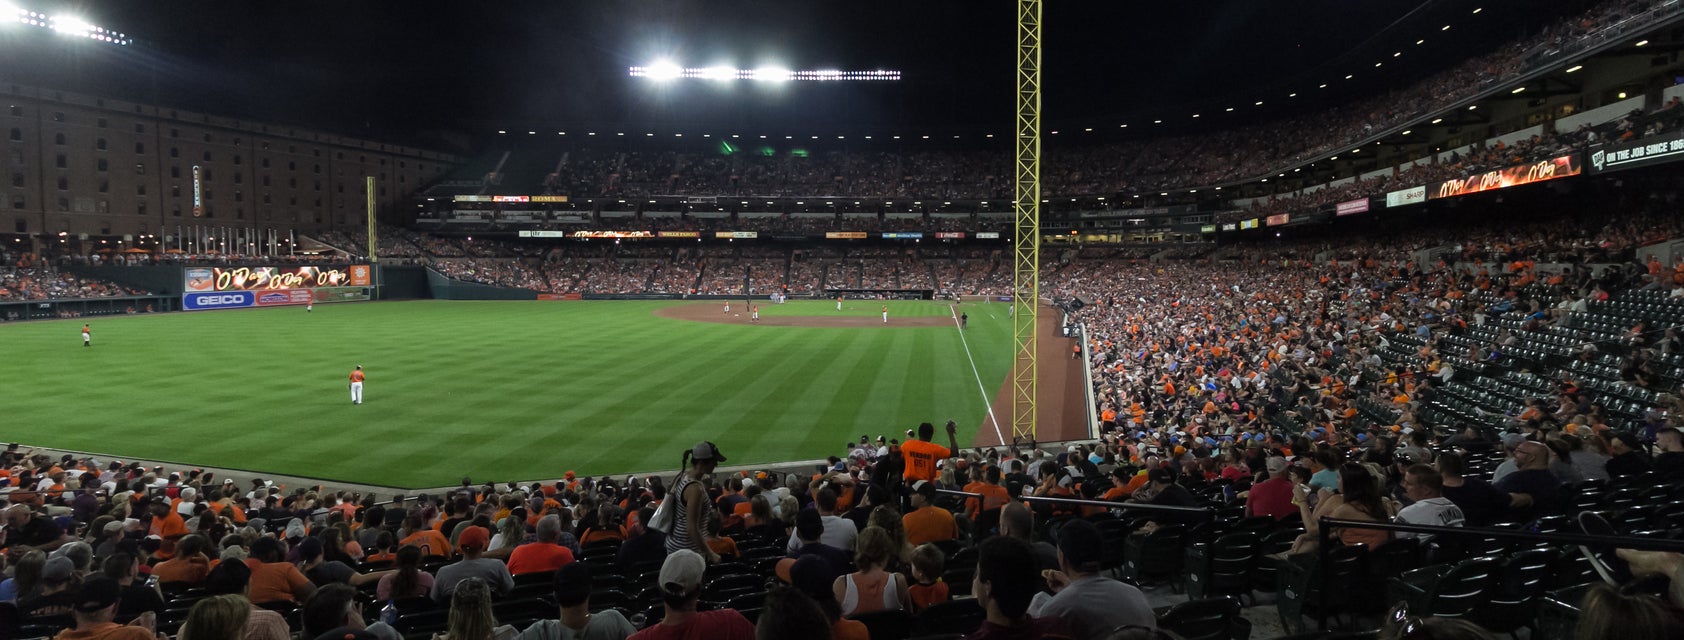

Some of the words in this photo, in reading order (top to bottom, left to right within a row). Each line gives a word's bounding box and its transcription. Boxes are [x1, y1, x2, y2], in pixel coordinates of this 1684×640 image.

[1606, 152, 1616, 162] ON
[1617, 149, 1630, 160] THE
[1631, 147, 1645, 158] JOB
[1646, 142, 1668, 155] SINCE
[1670, 139, 1684, 151] 186
[1406, 190, 1425, 200] SHARP
[217, 267, 264, 291] O'Day
[269, 272, 303, 290] O'Day
[317, 269, 347, 286] O'Day
[196, 294, 245, 306] GEICO
